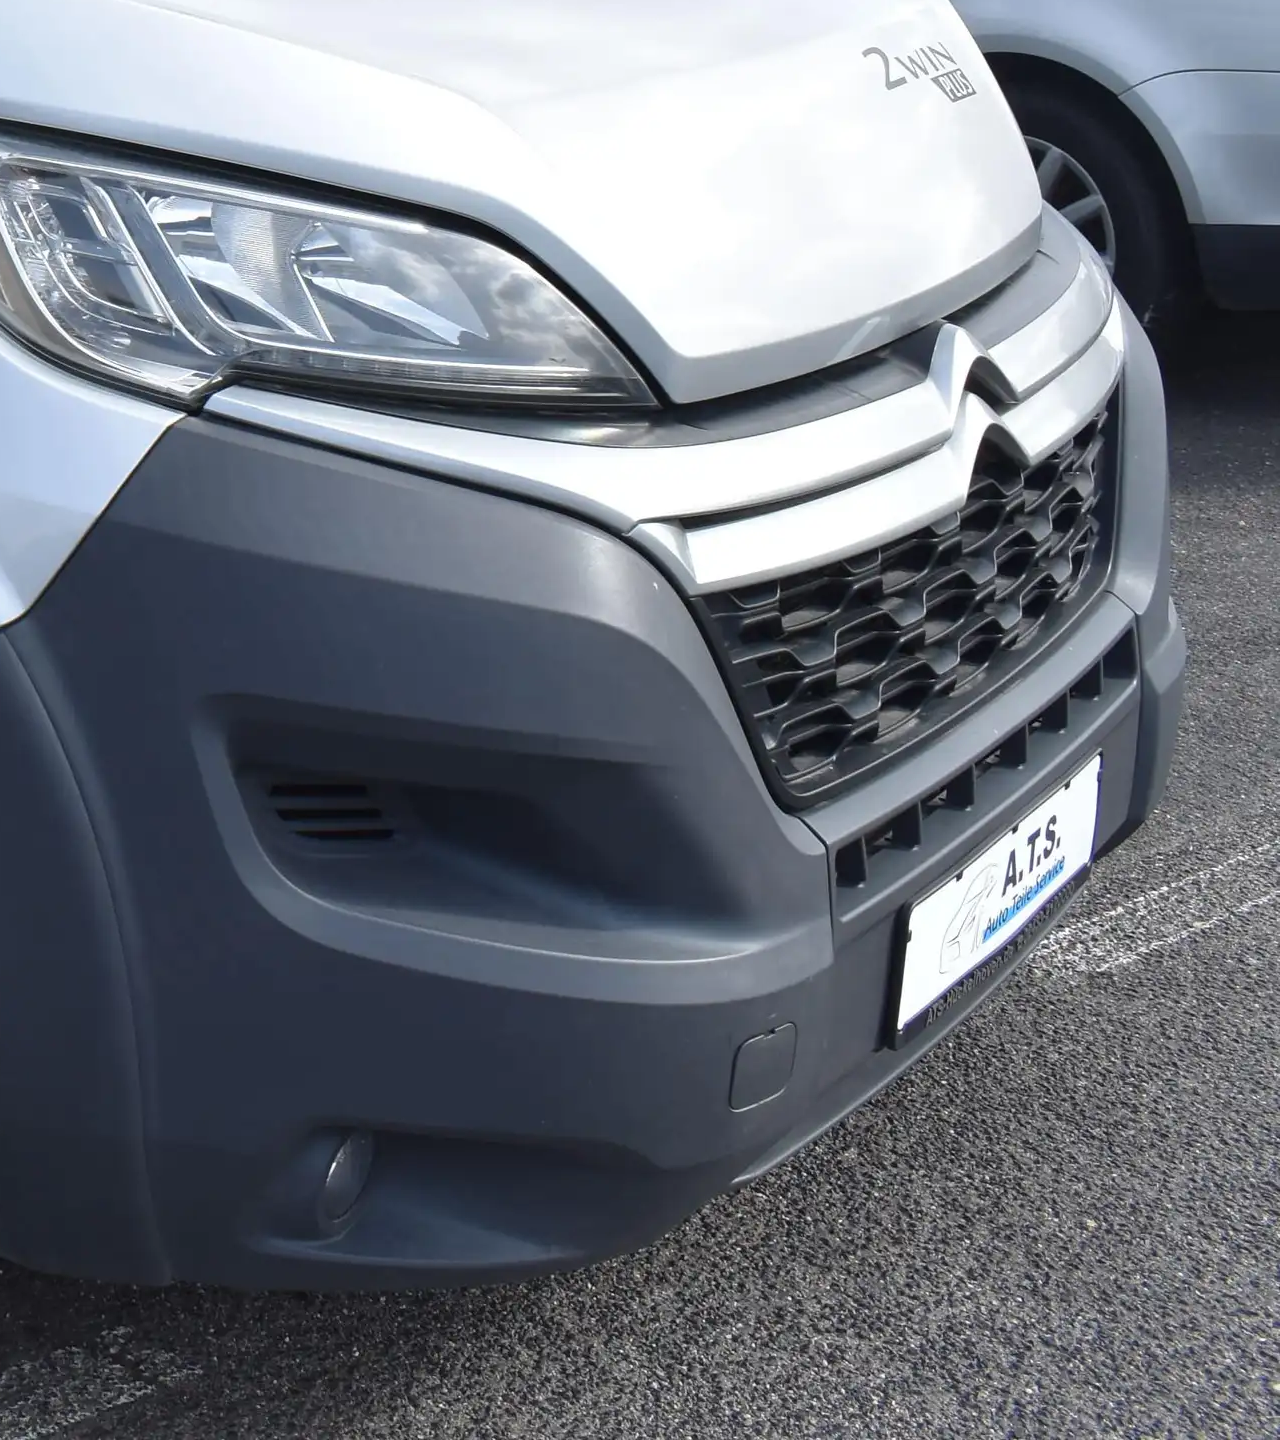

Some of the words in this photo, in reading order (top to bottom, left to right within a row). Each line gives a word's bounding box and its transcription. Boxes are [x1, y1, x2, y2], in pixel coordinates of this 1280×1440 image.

[861, 41, 959, 91] 2WIN
[937, 68, 975, 101] PLUS
[1001, 814, 1062, 898] A.T.S.
